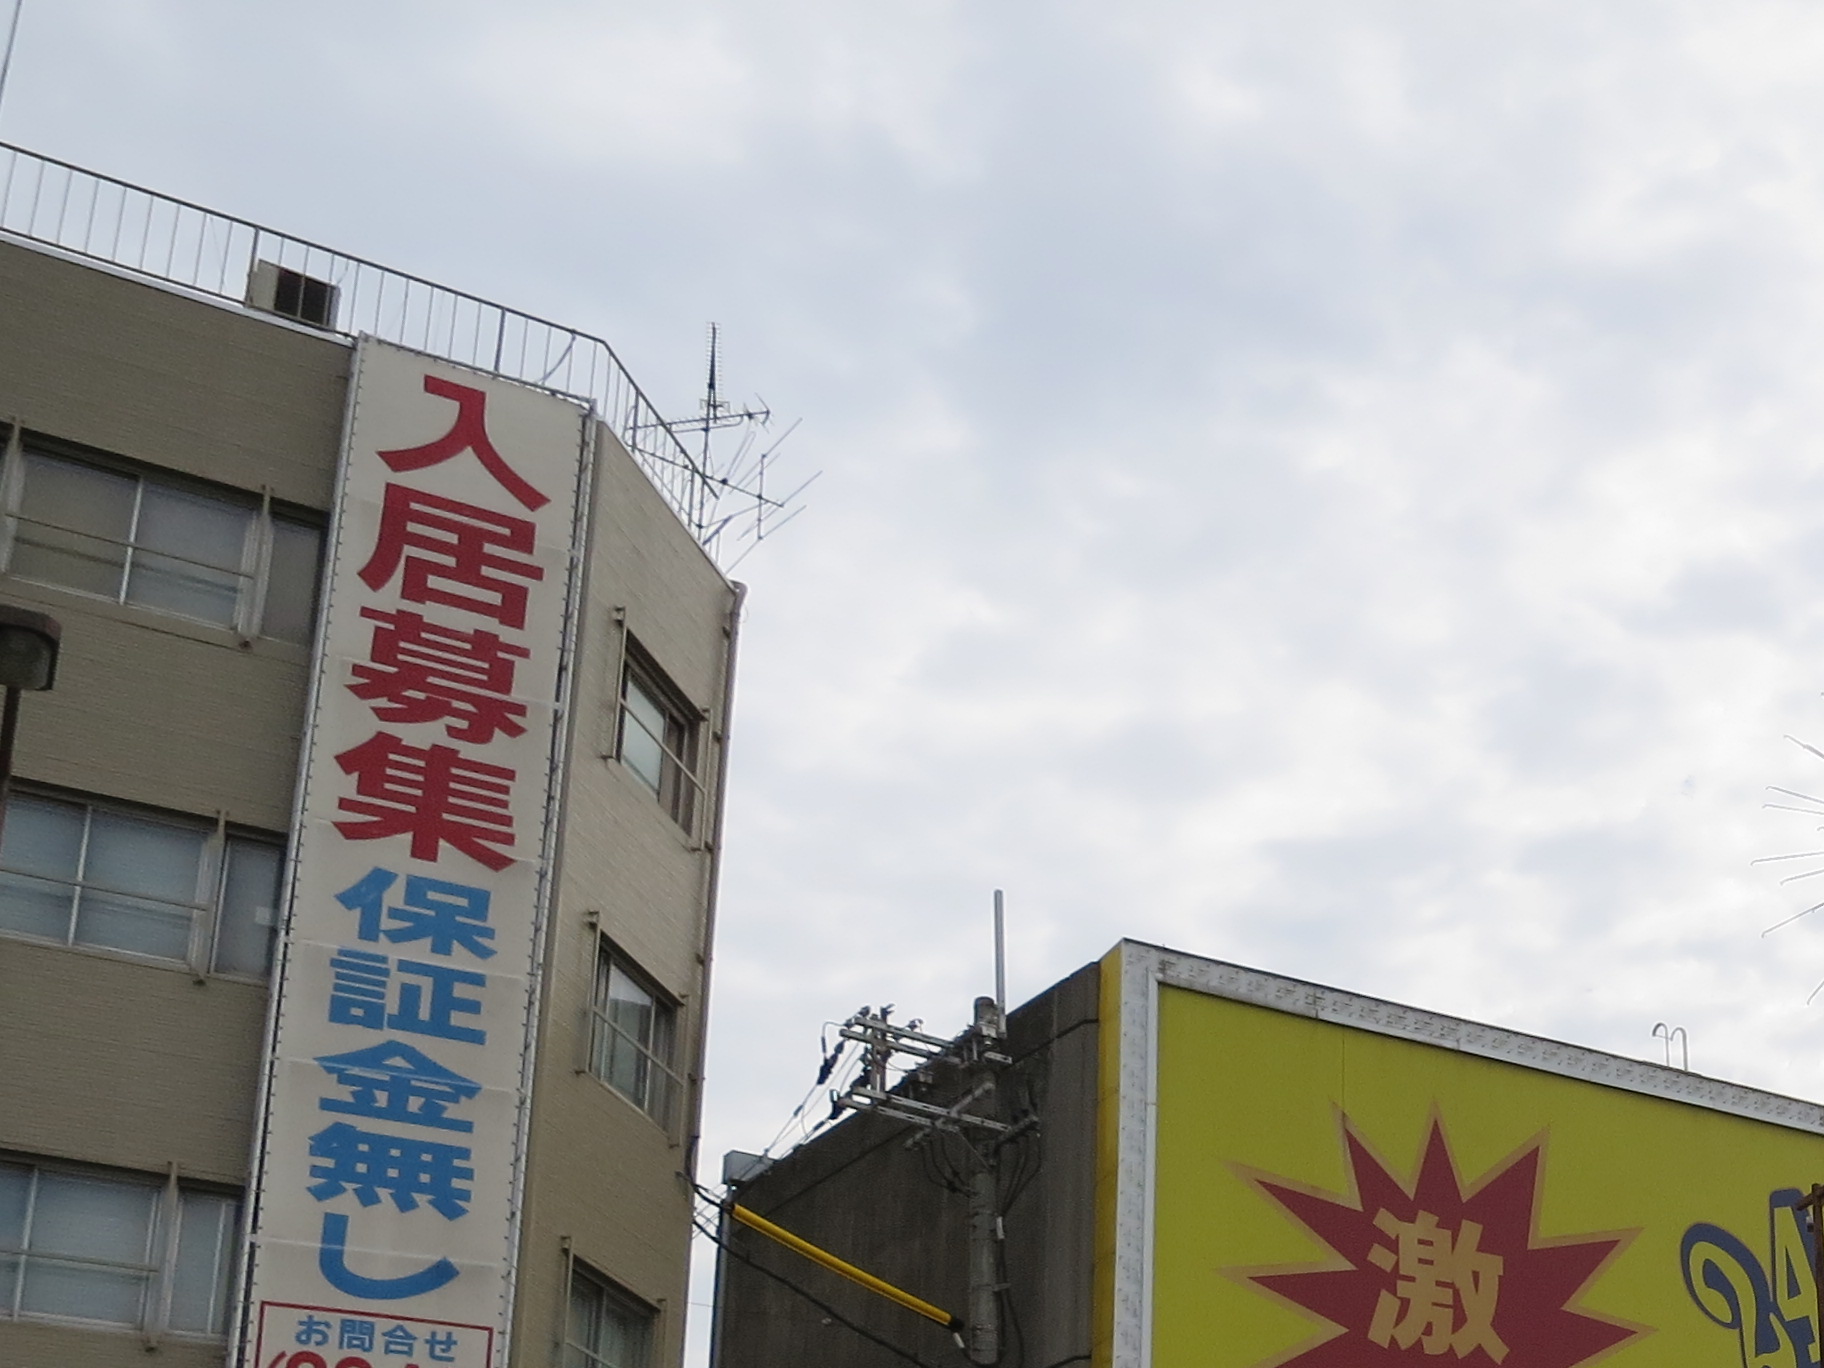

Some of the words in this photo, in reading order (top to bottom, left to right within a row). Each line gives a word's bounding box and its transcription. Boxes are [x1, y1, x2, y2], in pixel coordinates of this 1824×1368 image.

[333, 373, 551, 873] 入居募集
[307, 866, 498, 1300] 保証金無し
[295, 1315, 459, 1363] お問合せ
